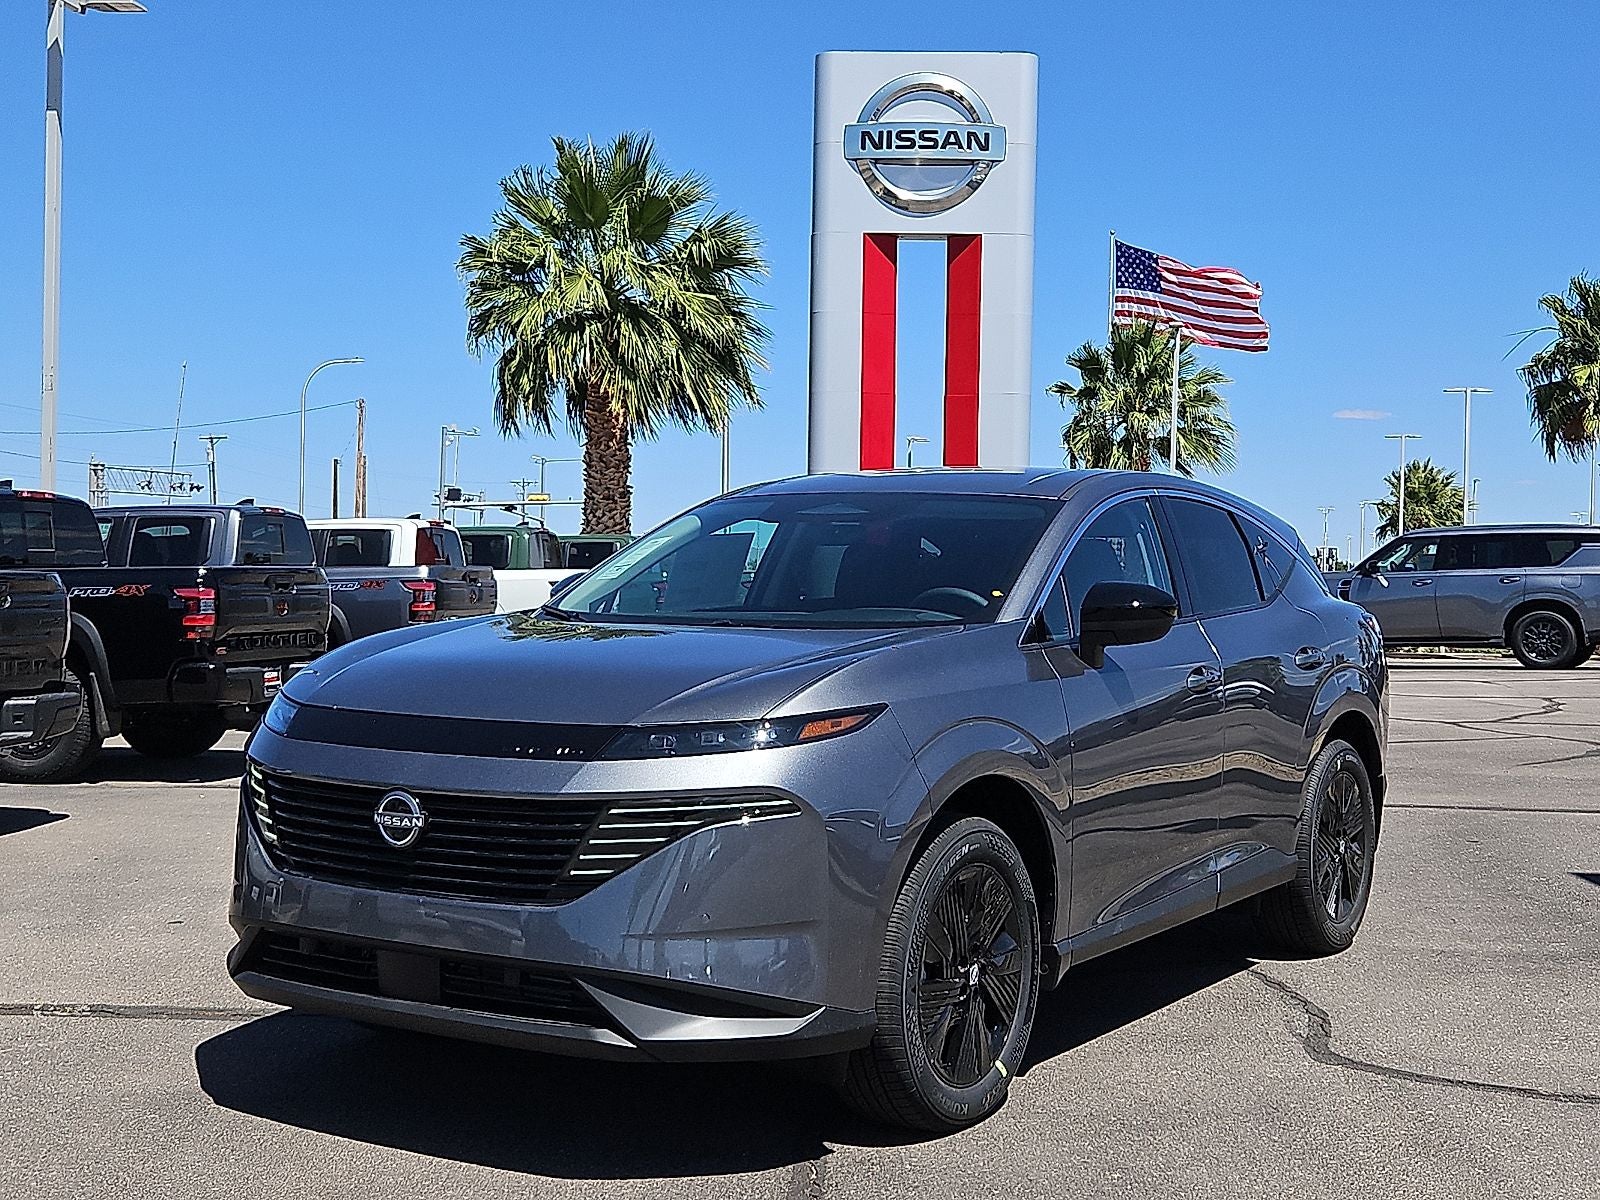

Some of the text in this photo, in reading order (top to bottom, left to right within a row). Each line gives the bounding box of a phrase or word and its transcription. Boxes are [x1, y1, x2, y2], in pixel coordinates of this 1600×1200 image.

[859, 130, 990, 152] NISSAN
[227, 632, 317, 651] FRONTIER
[373, 813, 423, 828] NISSAN
